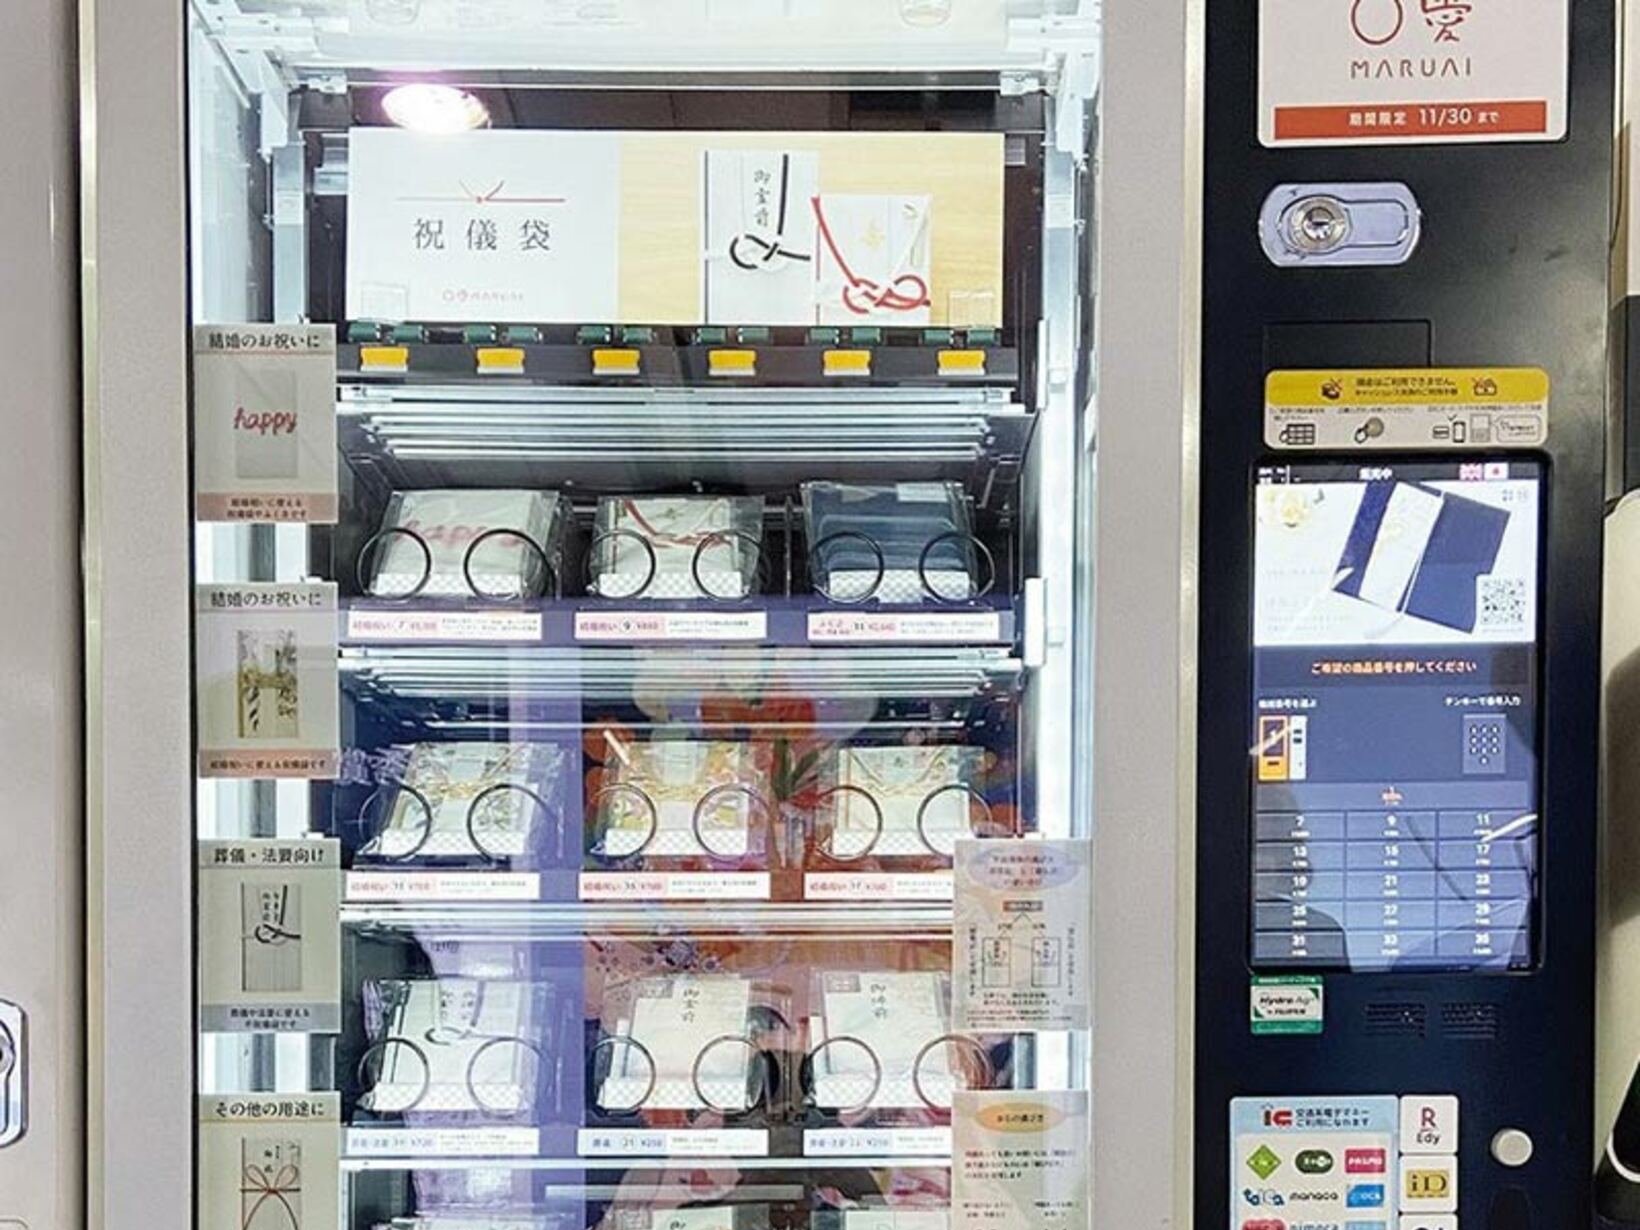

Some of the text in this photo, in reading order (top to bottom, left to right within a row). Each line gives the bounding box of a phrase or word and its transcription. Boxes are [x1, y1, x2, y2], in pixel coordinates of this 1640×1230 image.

[1350, 57, 1471, 79] MARUAI
[1349, 107, 1500, 126] 期間限定 11/30 まで
[413, 216, 552, 252] 祝儀袋
[208, 332, 321, 349] 結婚のお祝いに
[233, 407, 299, 436] happy
[211, 592, 323, 608] 結婚のお祝いに
[1477, 813, 1490, 825] 11
[213, 848, 324, 863] 葬儀・法要向け
[1476, 844, 1490, 854] 17
[216, 1101, 324, 1117] その他の用途に
[1416, 1132, 1441, 1146] Edy
[1288, 1191, 1340, 1201] manaca
